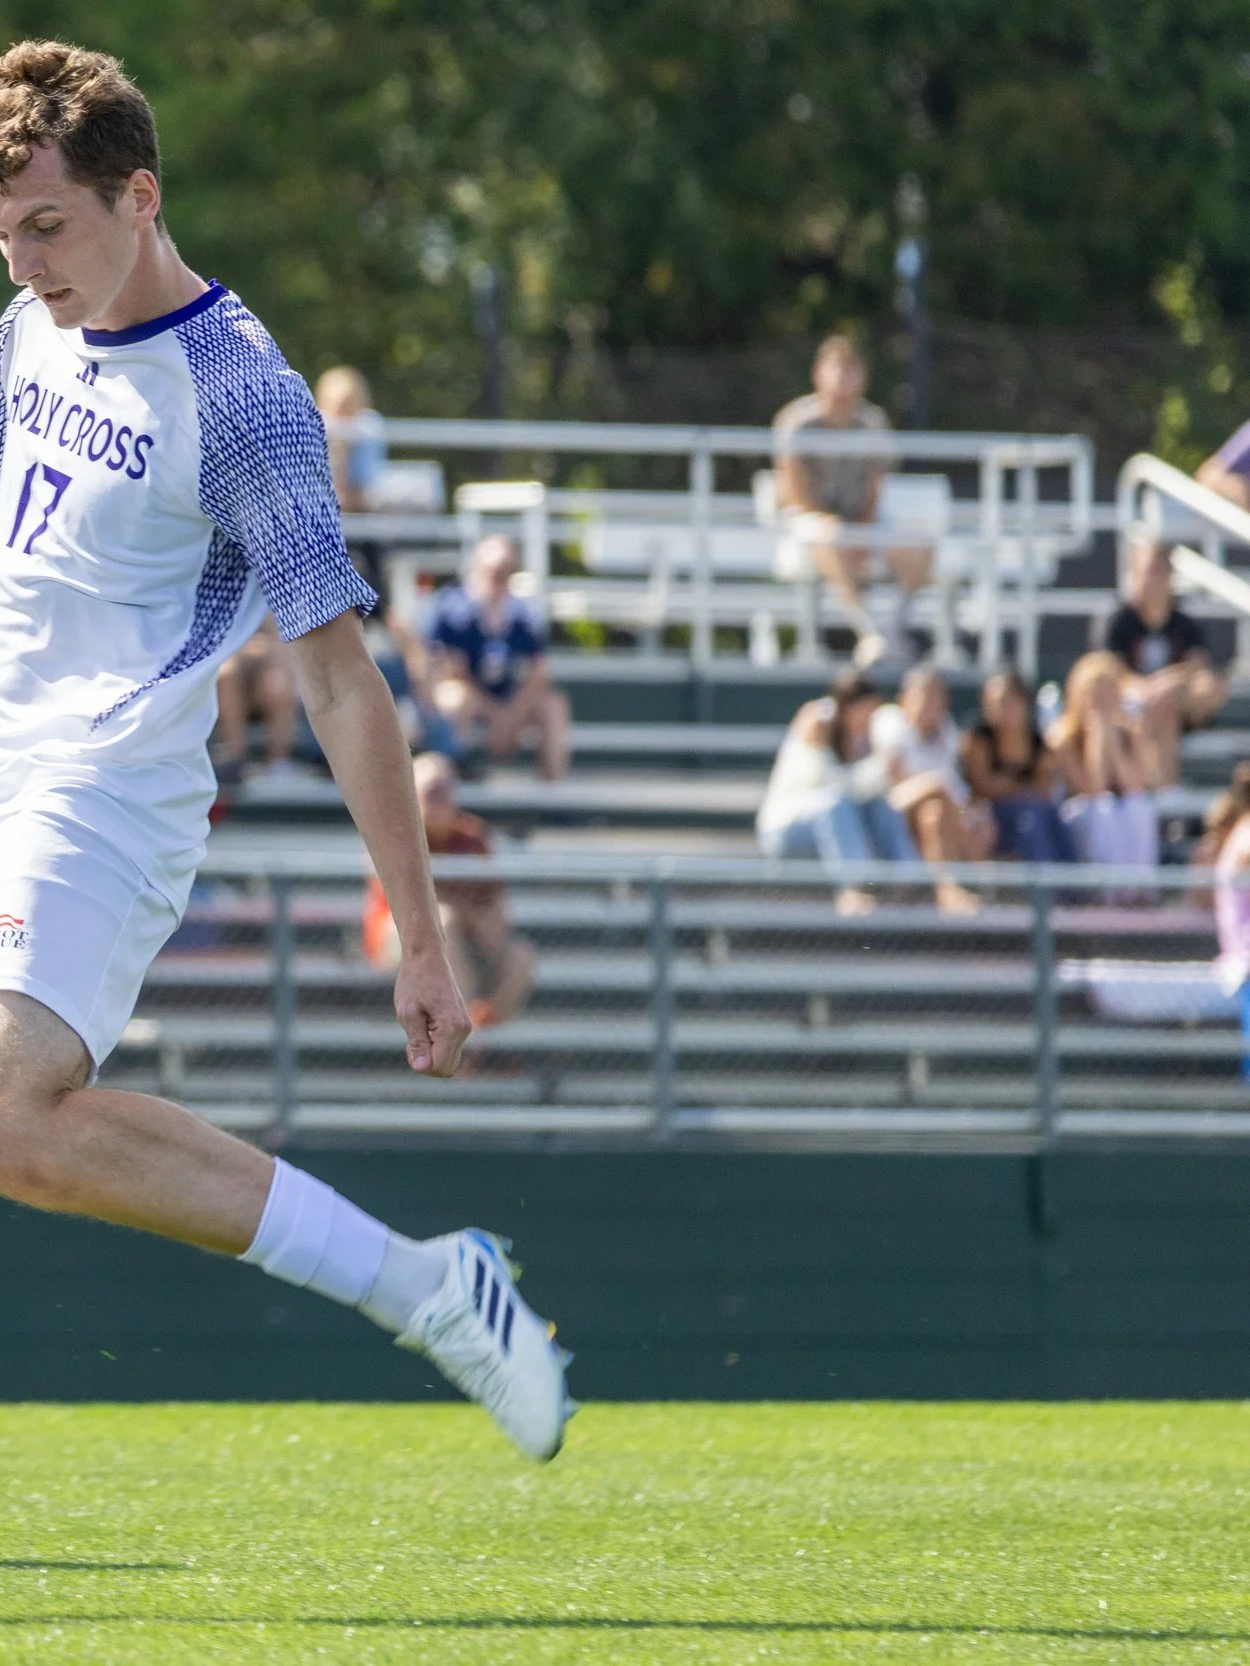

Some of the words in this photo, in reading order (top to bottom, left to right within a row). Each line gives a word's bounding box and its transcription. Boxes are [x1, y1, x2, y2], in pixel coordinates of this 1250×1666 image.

[7, 375, 64, 440] HOLY
[58, 403, 155, 480] CROSS
[6, 461, 73, 555] 17
